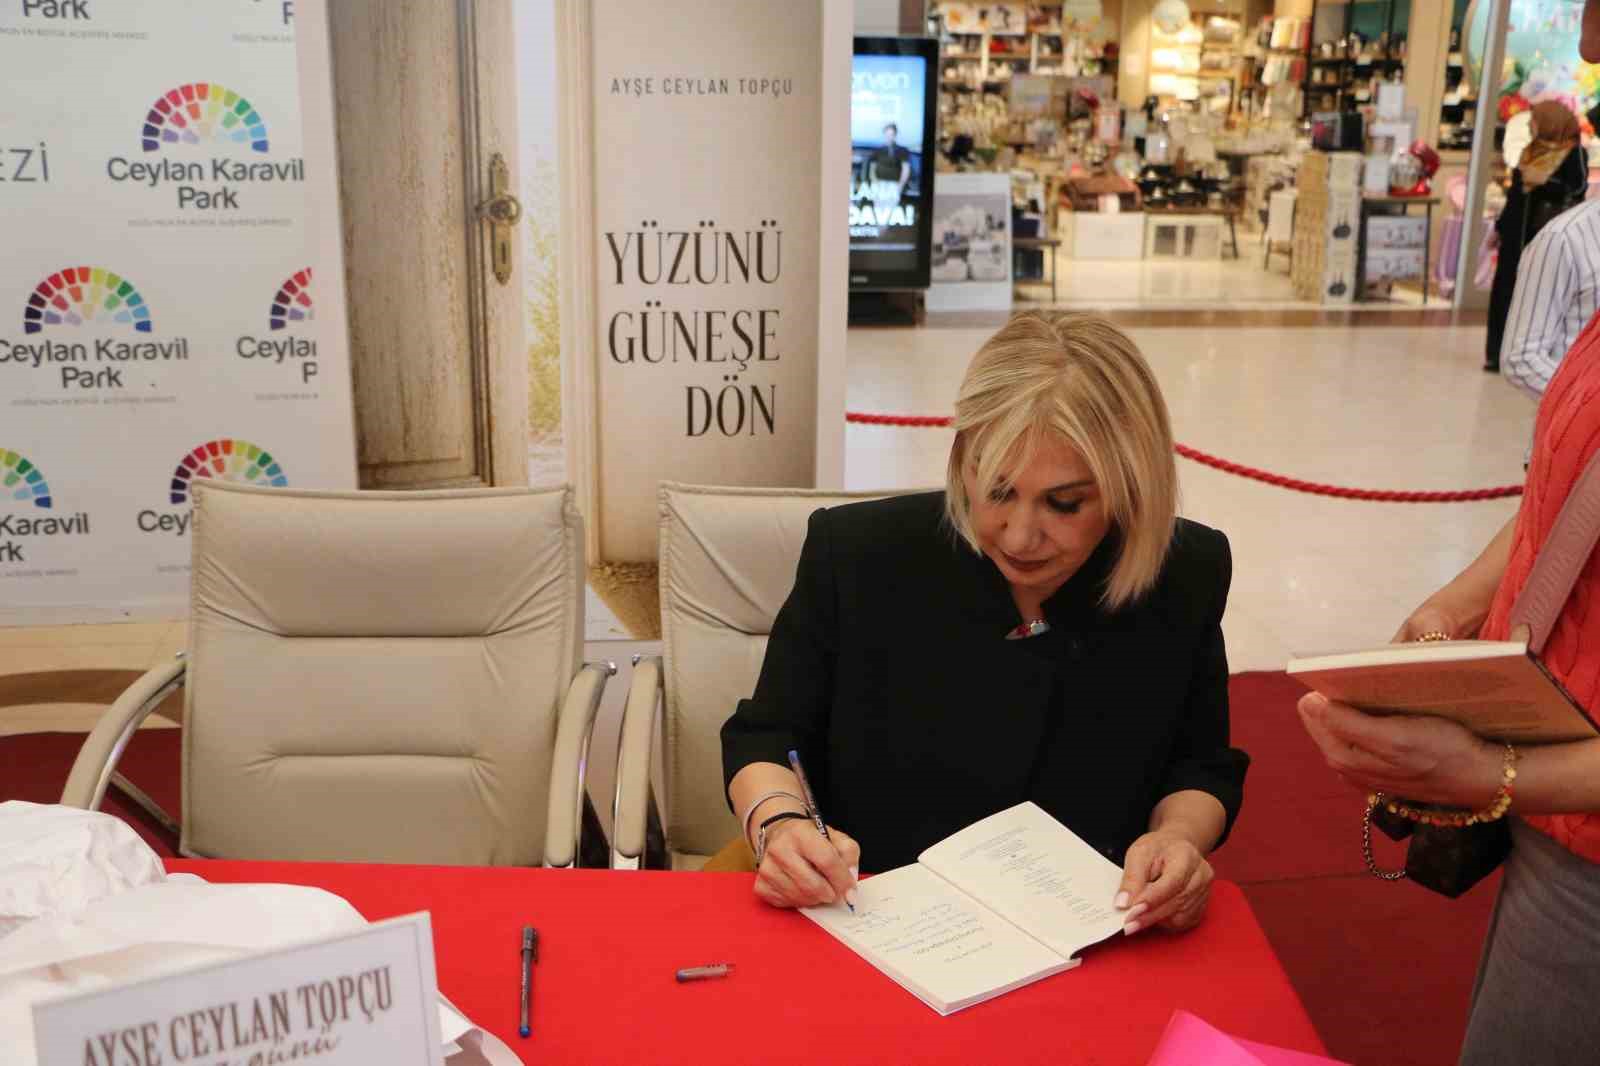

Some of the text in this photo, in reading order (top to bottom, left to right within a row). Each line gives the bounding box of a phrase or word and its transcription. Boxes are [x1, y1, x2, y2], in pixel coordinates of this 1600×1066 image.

[22, 0, 92, 20] Park
[610, 77, 793, 98] AYŞE CEYLAN TOPÇU
[107, 157, 305, 187] Ceylan Karavil
[177, 186, 239, 210] Park
[604, 219, 783, 285] YÜZÜNÜ
[608, 300, 781, 372] GÜNEŞE
[0, 337, 189, 368] Ceylan Karavil
[61, 365, 123, 389] Park
[685, 374, 777, 437] DÖN
[169, 990, 291, 1063] CEYLAN
[297, 965, 393, 1031] TOPÇU
